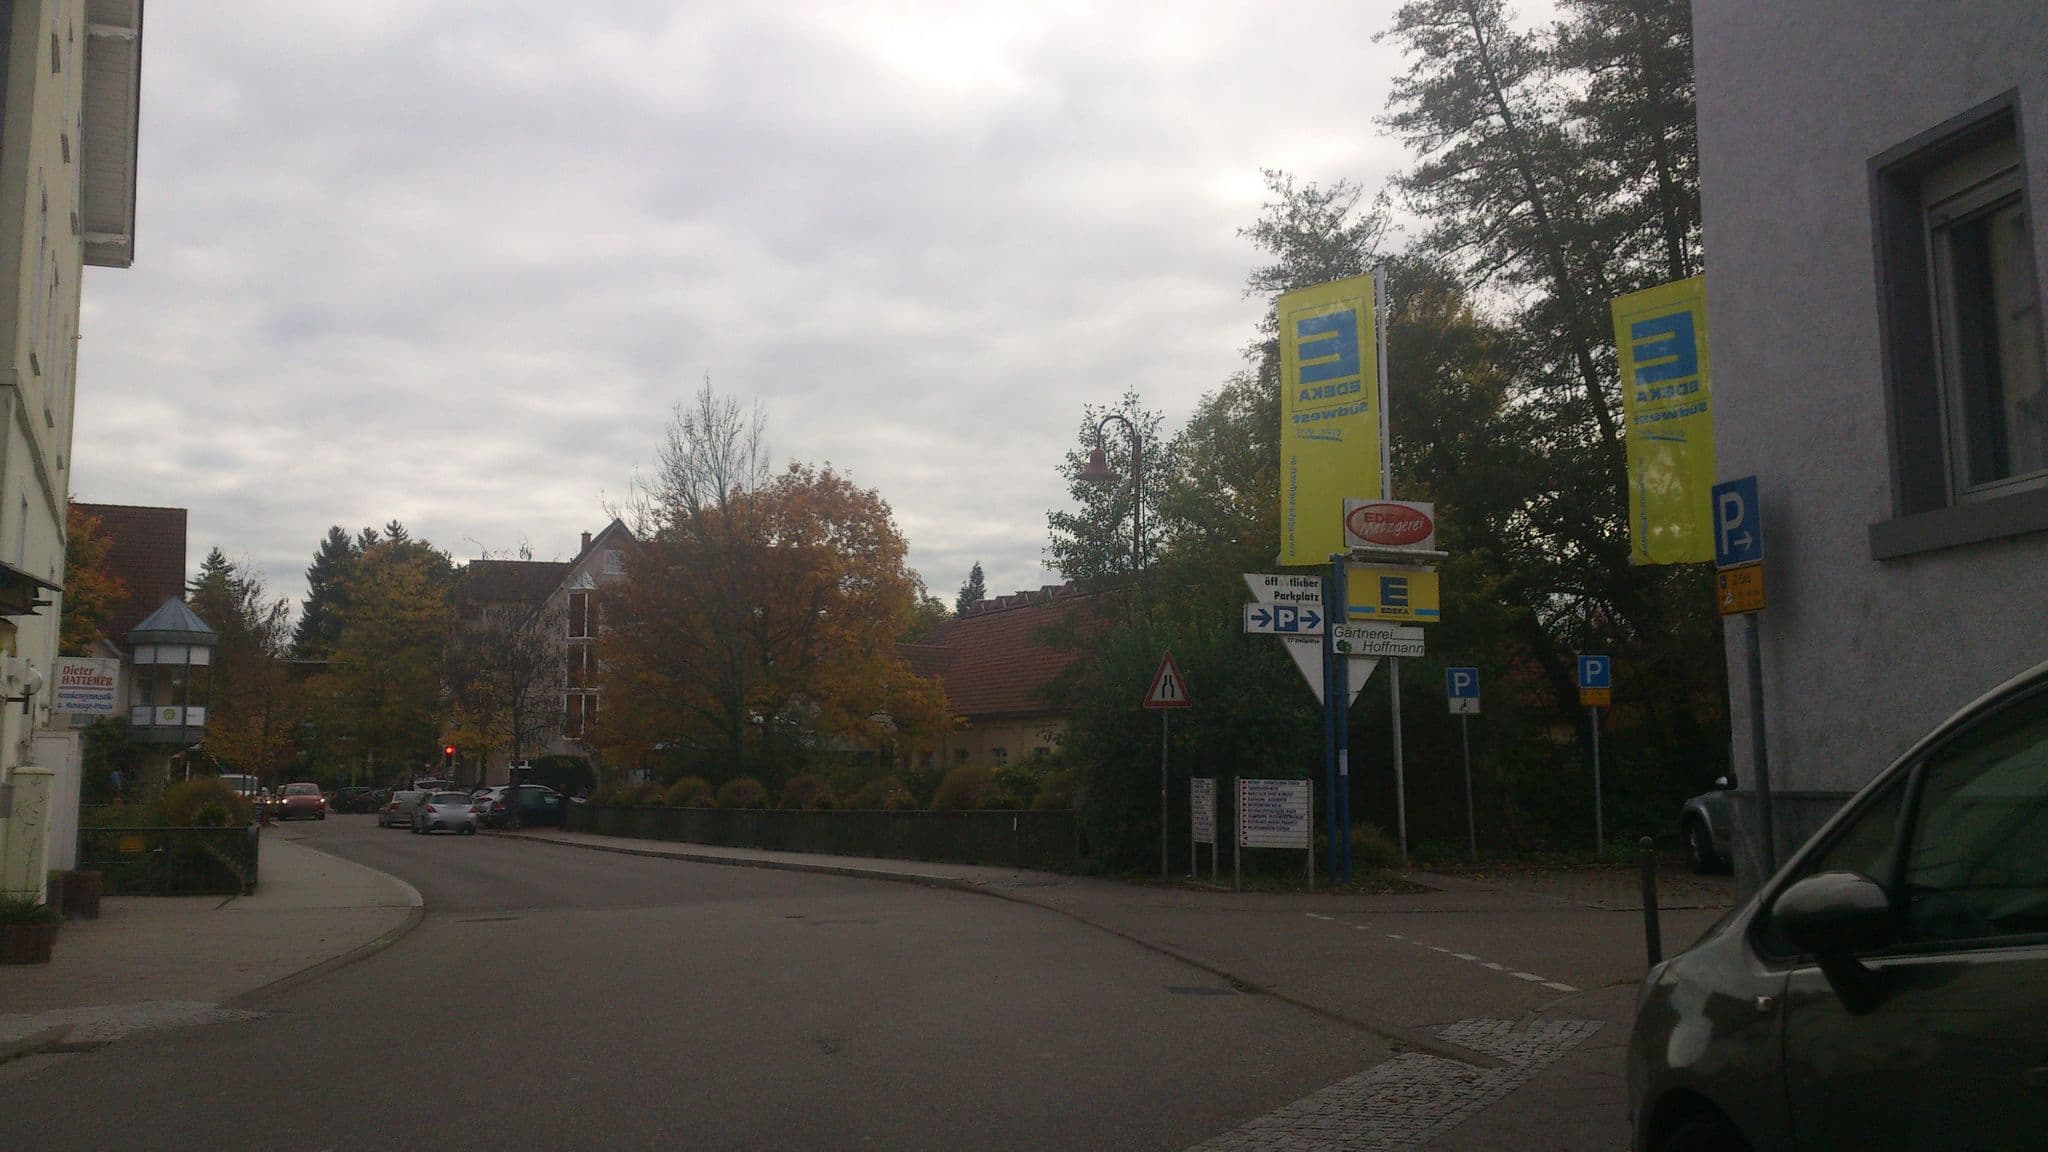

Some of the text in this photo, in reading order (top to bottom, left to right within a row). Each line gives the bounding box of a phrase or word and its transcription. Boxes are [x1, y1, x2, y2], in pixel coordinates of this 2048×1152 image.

[1359, 517, 1425, 537] Metzgerei
[1719, 491, 1745, 556] P
[1265, 576, 1318, 588] öfftlicher
[1274, 591, 1320, 603] Parkplatz
[1278, 609, 1294, 628] P
[1380, 607, 1410, 616] EDEKA
[1334, 626, 1394, 641] Gärtnerei
[1362, 640, 1425, 654] Hoffmann
[63, 664, 94, 676] Dieter
[1586, 660, 1602, 684] P
[62, 676, 113, 686] HATTEMER
[1454, 672, 1471, 696] P
